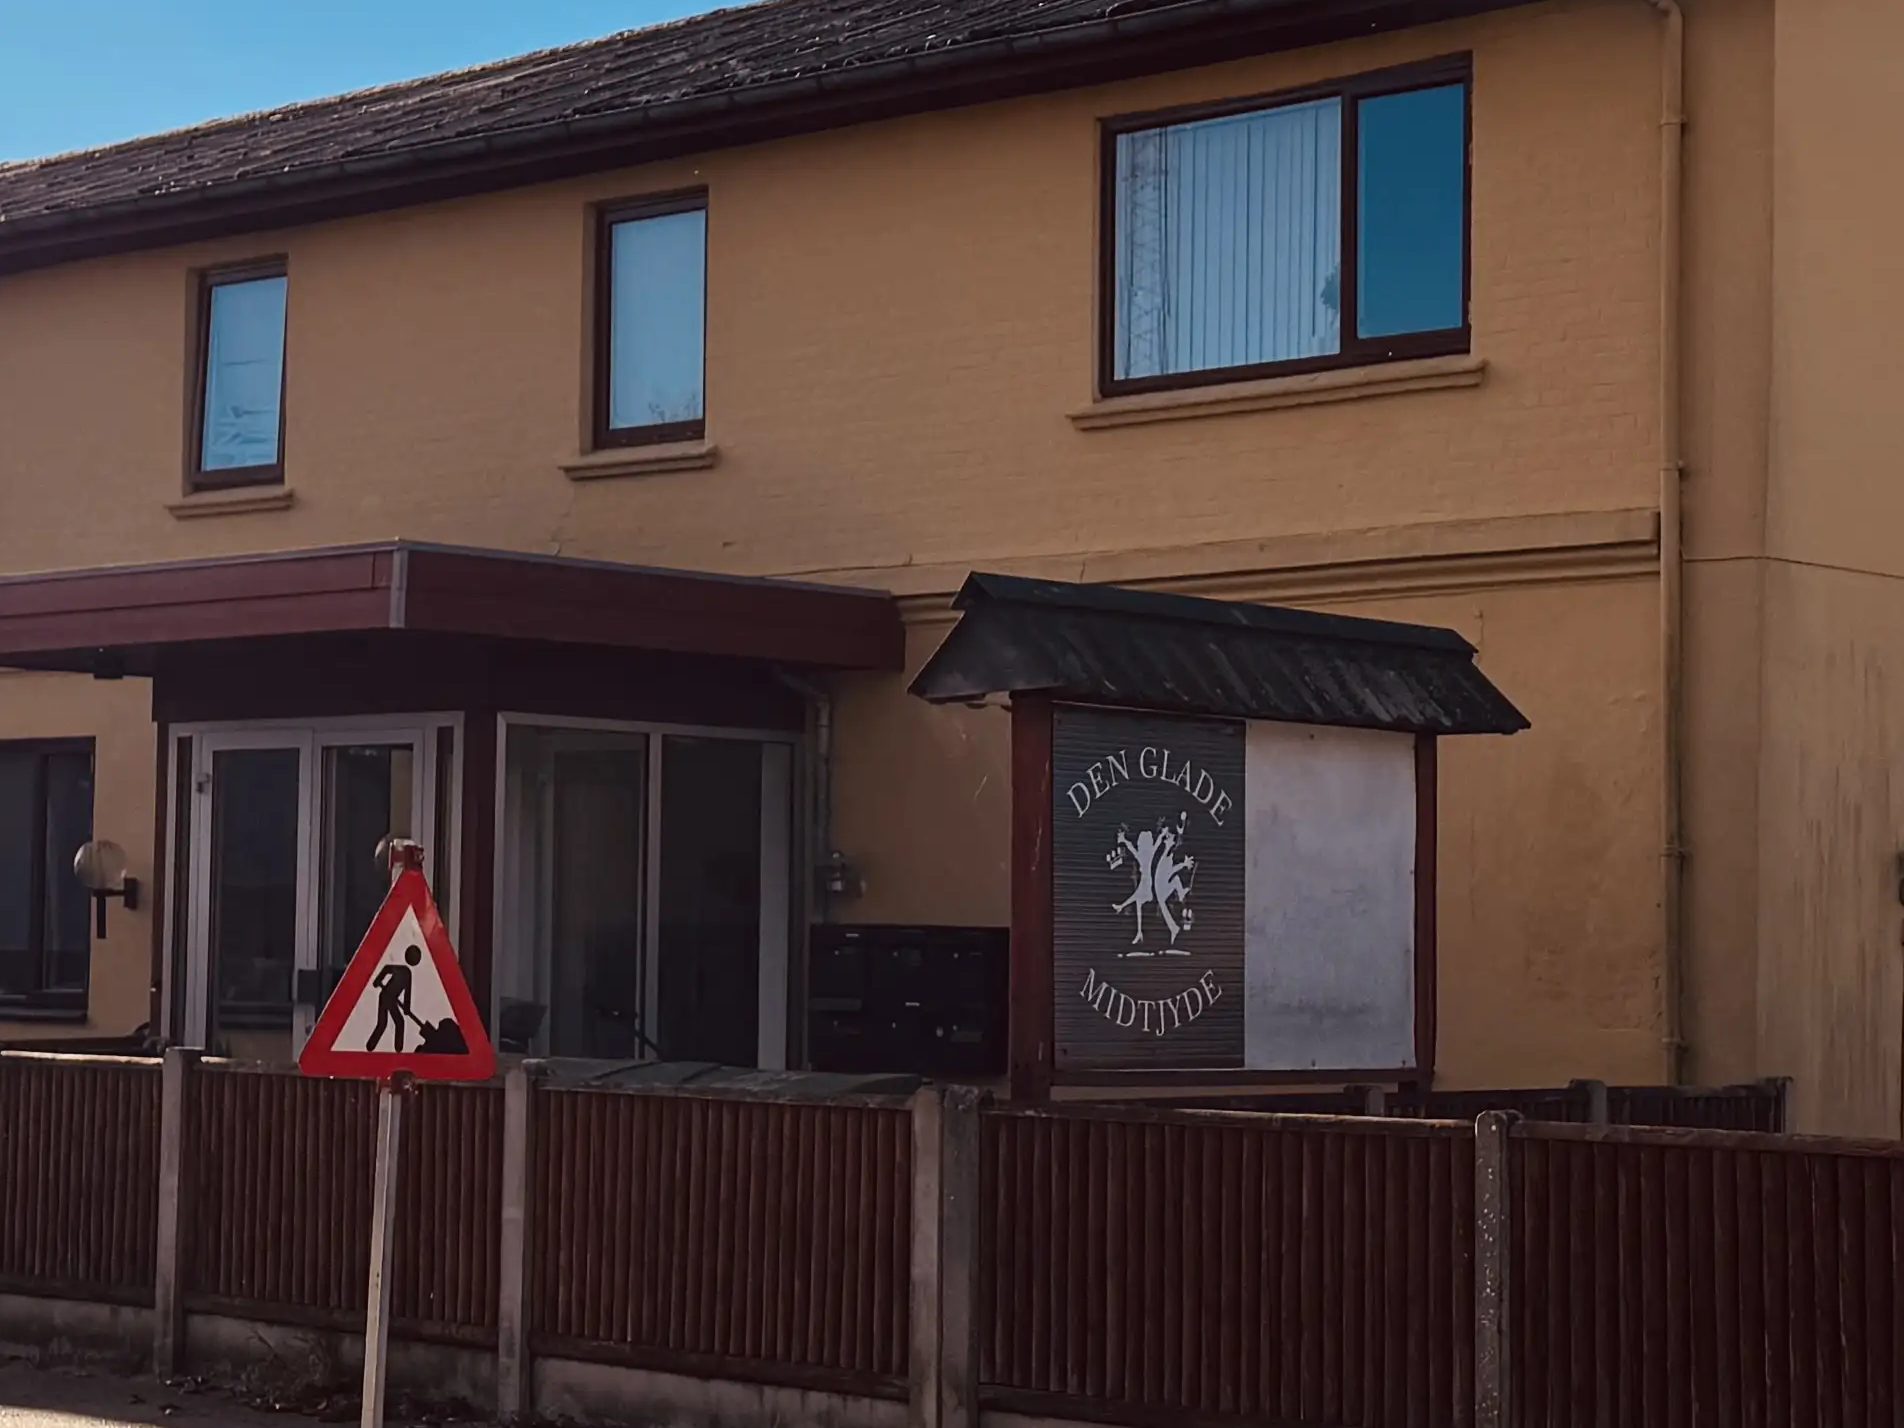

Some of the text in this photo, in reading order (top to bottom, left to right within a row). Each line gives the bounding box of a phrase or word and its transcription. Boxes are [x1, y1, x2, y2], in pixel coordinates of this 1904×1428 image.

[1066, 746, 1233, 826] DEN GLADE
[1080, 968, 1222, 1036] MIDTJYDE
